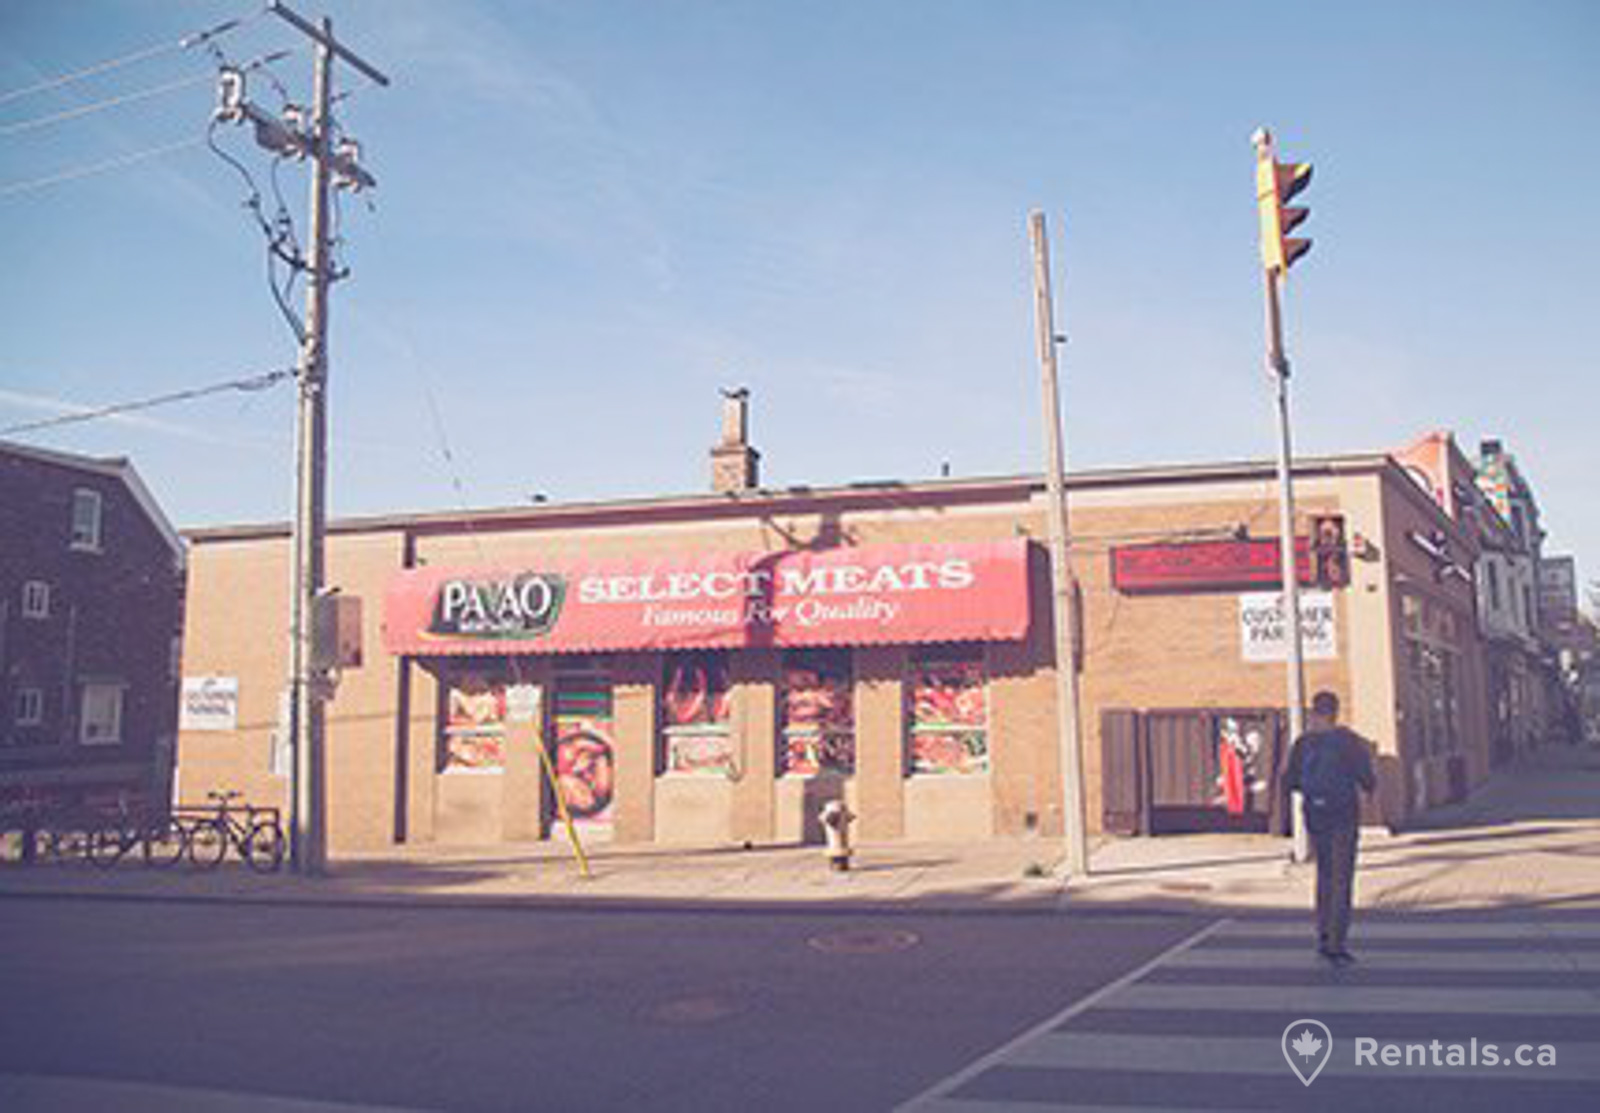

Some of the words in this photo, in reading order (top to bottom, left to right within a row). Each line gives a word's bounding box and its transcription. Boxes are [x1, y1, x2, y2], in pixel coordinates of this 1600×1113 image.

[580, 570, 773, 604] SELECT
[780, 560, 974, 597] MEATS
[642, 606, 738, 626] Famous
[743, 600, 787, 624] For
[797, 598, 894, 626] Quality
[1242, 606, 1334, 626] CUSTMER
[1250, 626, 1328, 641] PARNG
